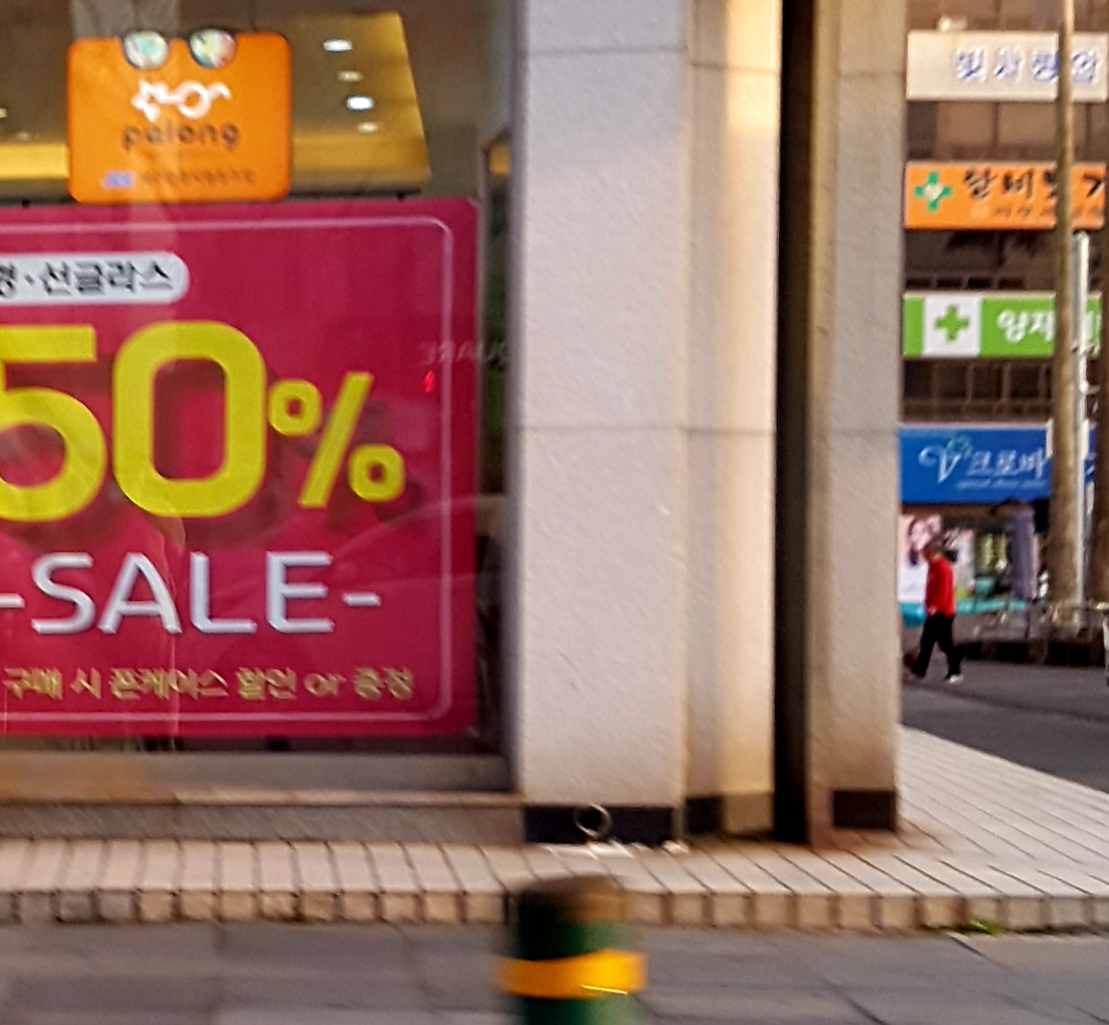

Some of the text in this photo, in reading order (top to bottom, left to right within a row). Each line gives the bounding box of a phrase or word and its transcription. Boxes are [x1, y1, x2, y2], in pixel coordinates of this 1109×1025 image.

[121, 119, 240, 151] palong
[3, 666, 63, 701] 구매
[71, 666, 102, 700] 시
[109, 666, 229, 701] 폰케이스
[235, 666, 296, 701] 할인
[303, 673, 347, 697] or
[354, 666, 413, 701] 증정
